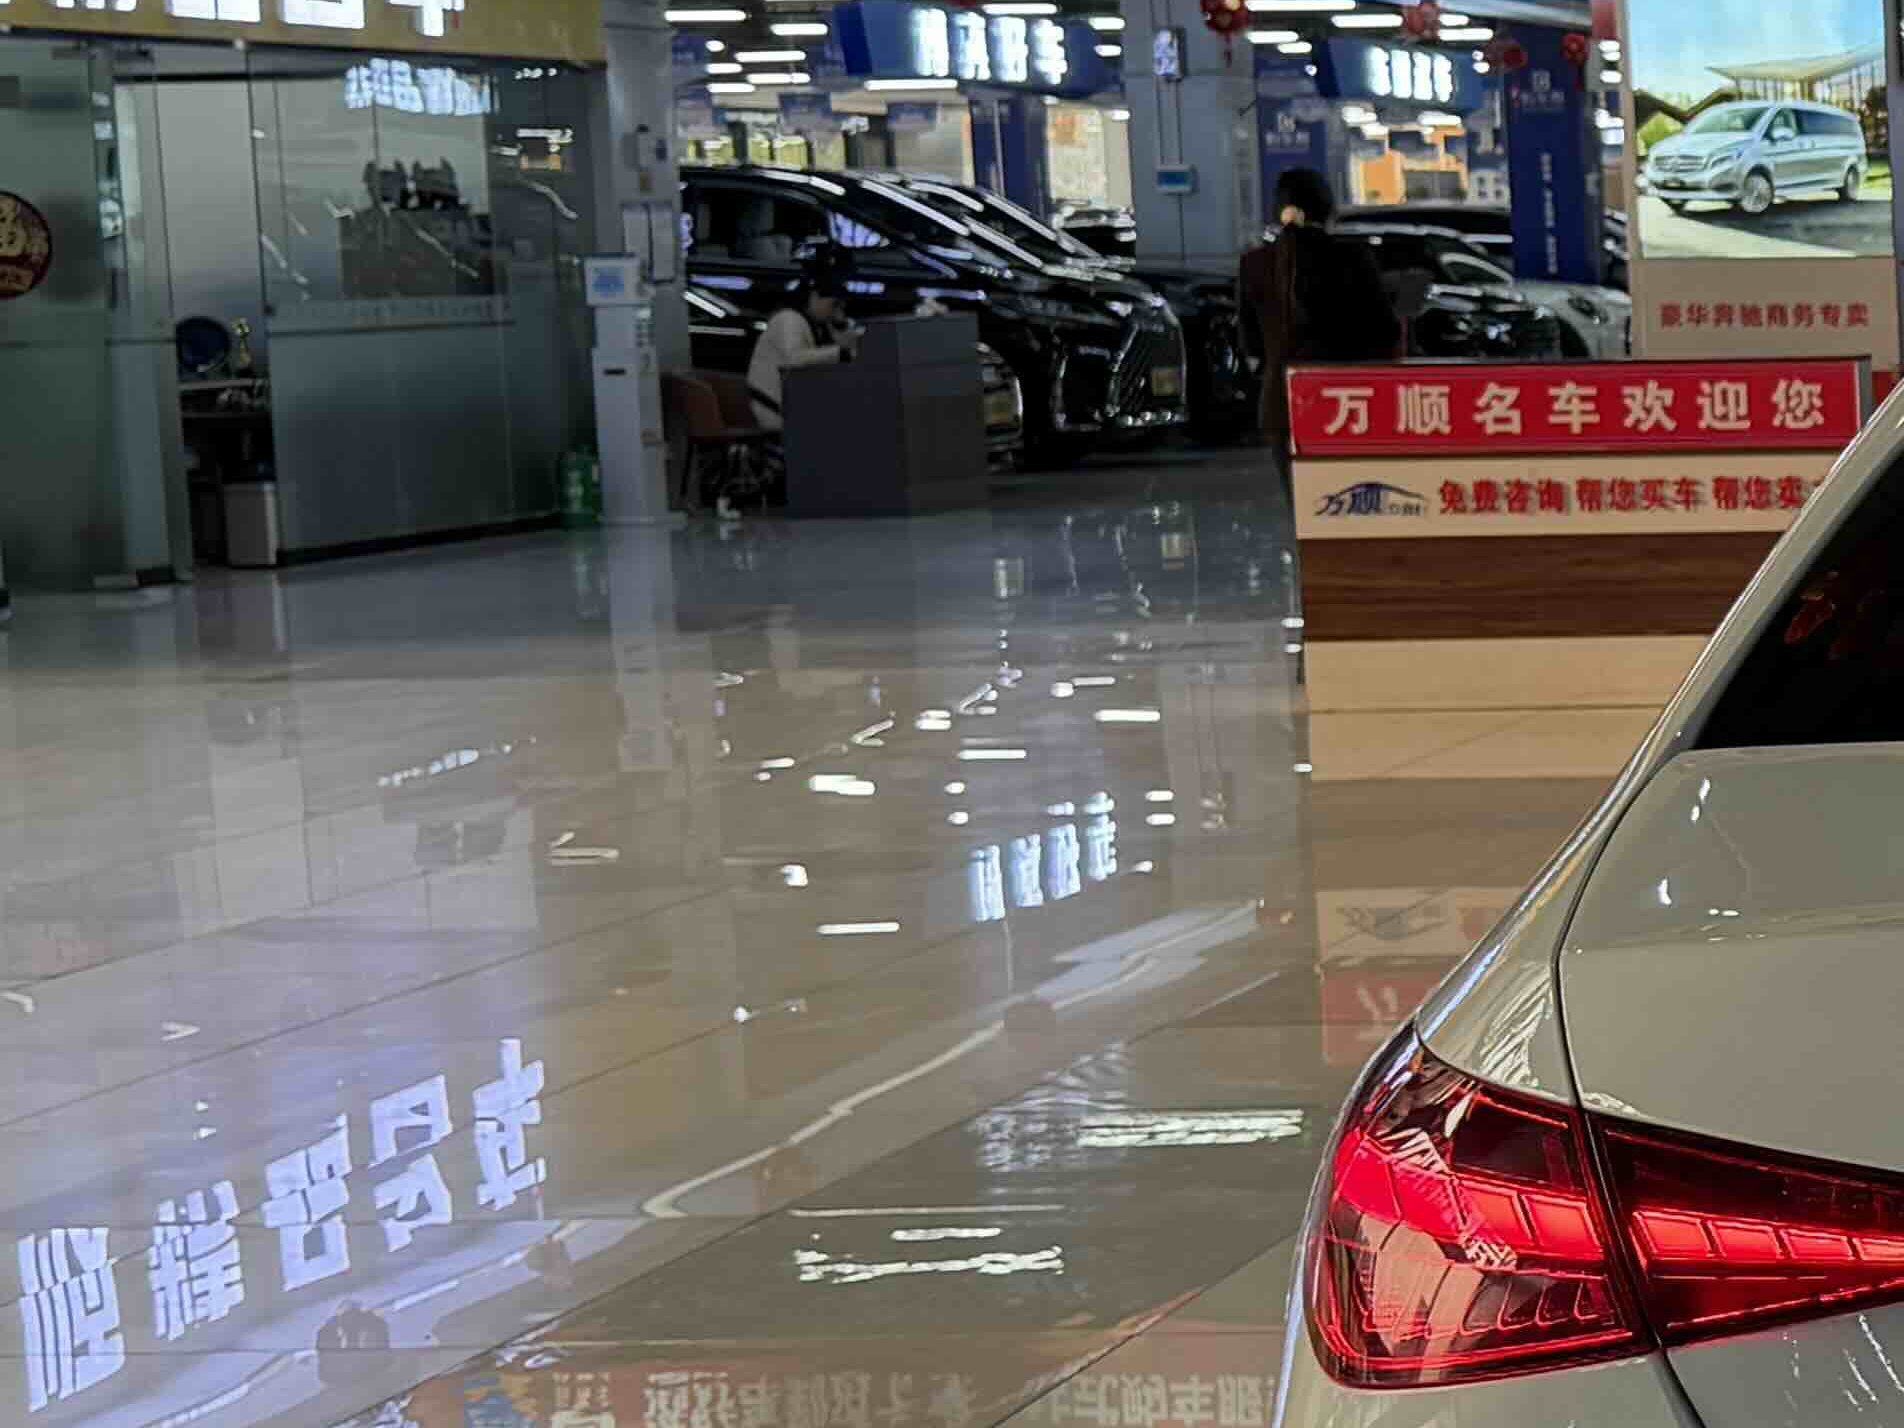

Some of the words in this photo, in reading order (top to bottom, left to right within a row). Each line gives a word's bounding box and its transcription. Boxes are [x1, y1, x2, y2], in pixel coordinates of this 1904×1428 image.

[1659, 302, 1870, 329] 豪华奔驰商务专卖
[1322, 379, 1826, 436] 万顺名车欢迎您
[1438, 478, 1570, 516] 免费咨询
[1576, 476, 1701, 514] 帮您买车
